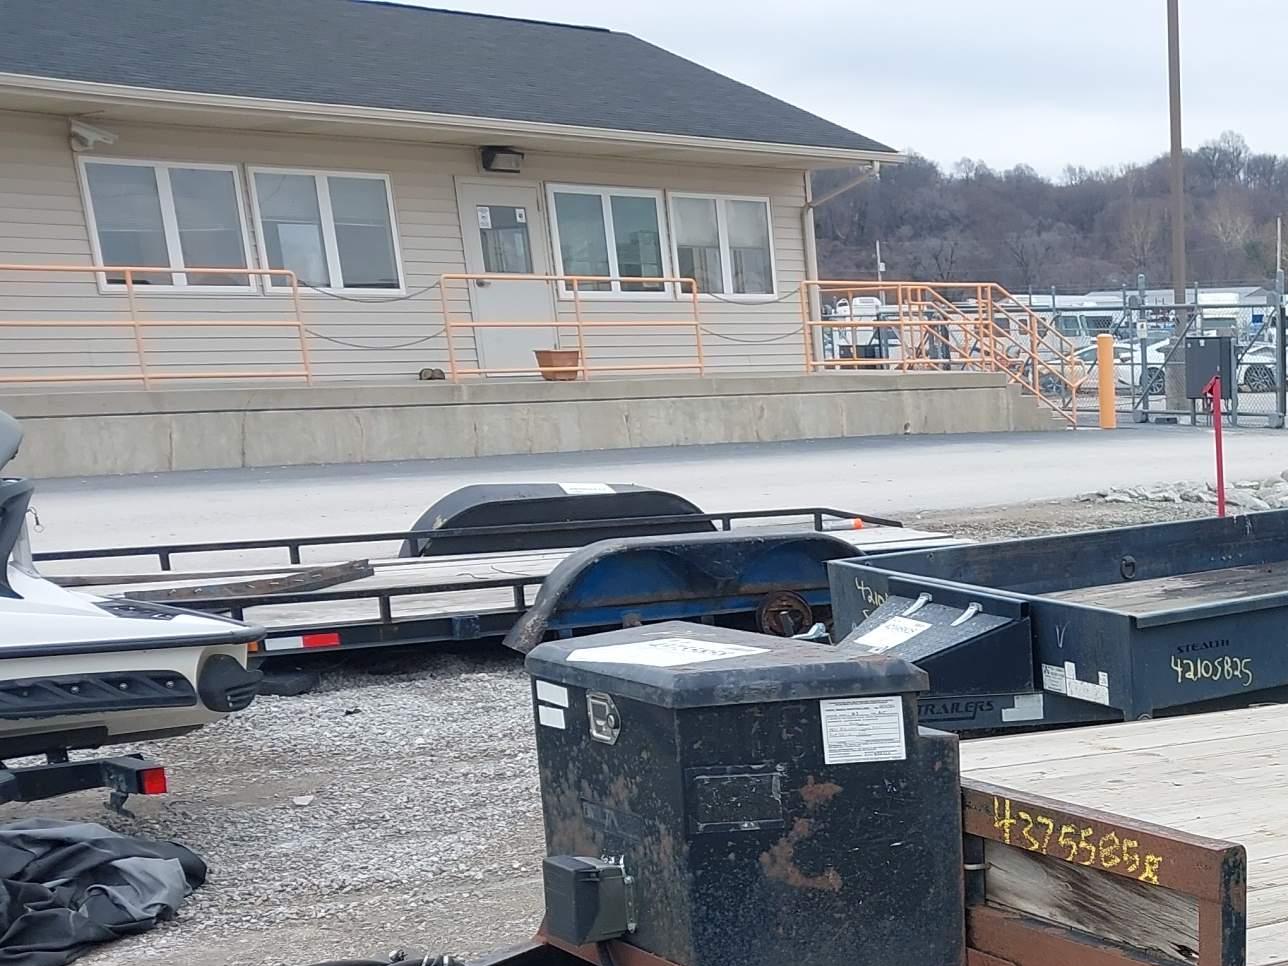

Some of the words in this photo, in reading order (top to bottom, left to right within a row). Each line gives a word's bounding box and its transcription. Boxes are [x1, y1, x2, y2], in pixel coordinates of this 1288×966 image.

[1177, 640, 1230, 654] STEALTH
[1171, 655, 1252, 687] 42105825
[917, 700, 994, 719] TRAILERS
[993, 796, 1162, 885] 43755858
